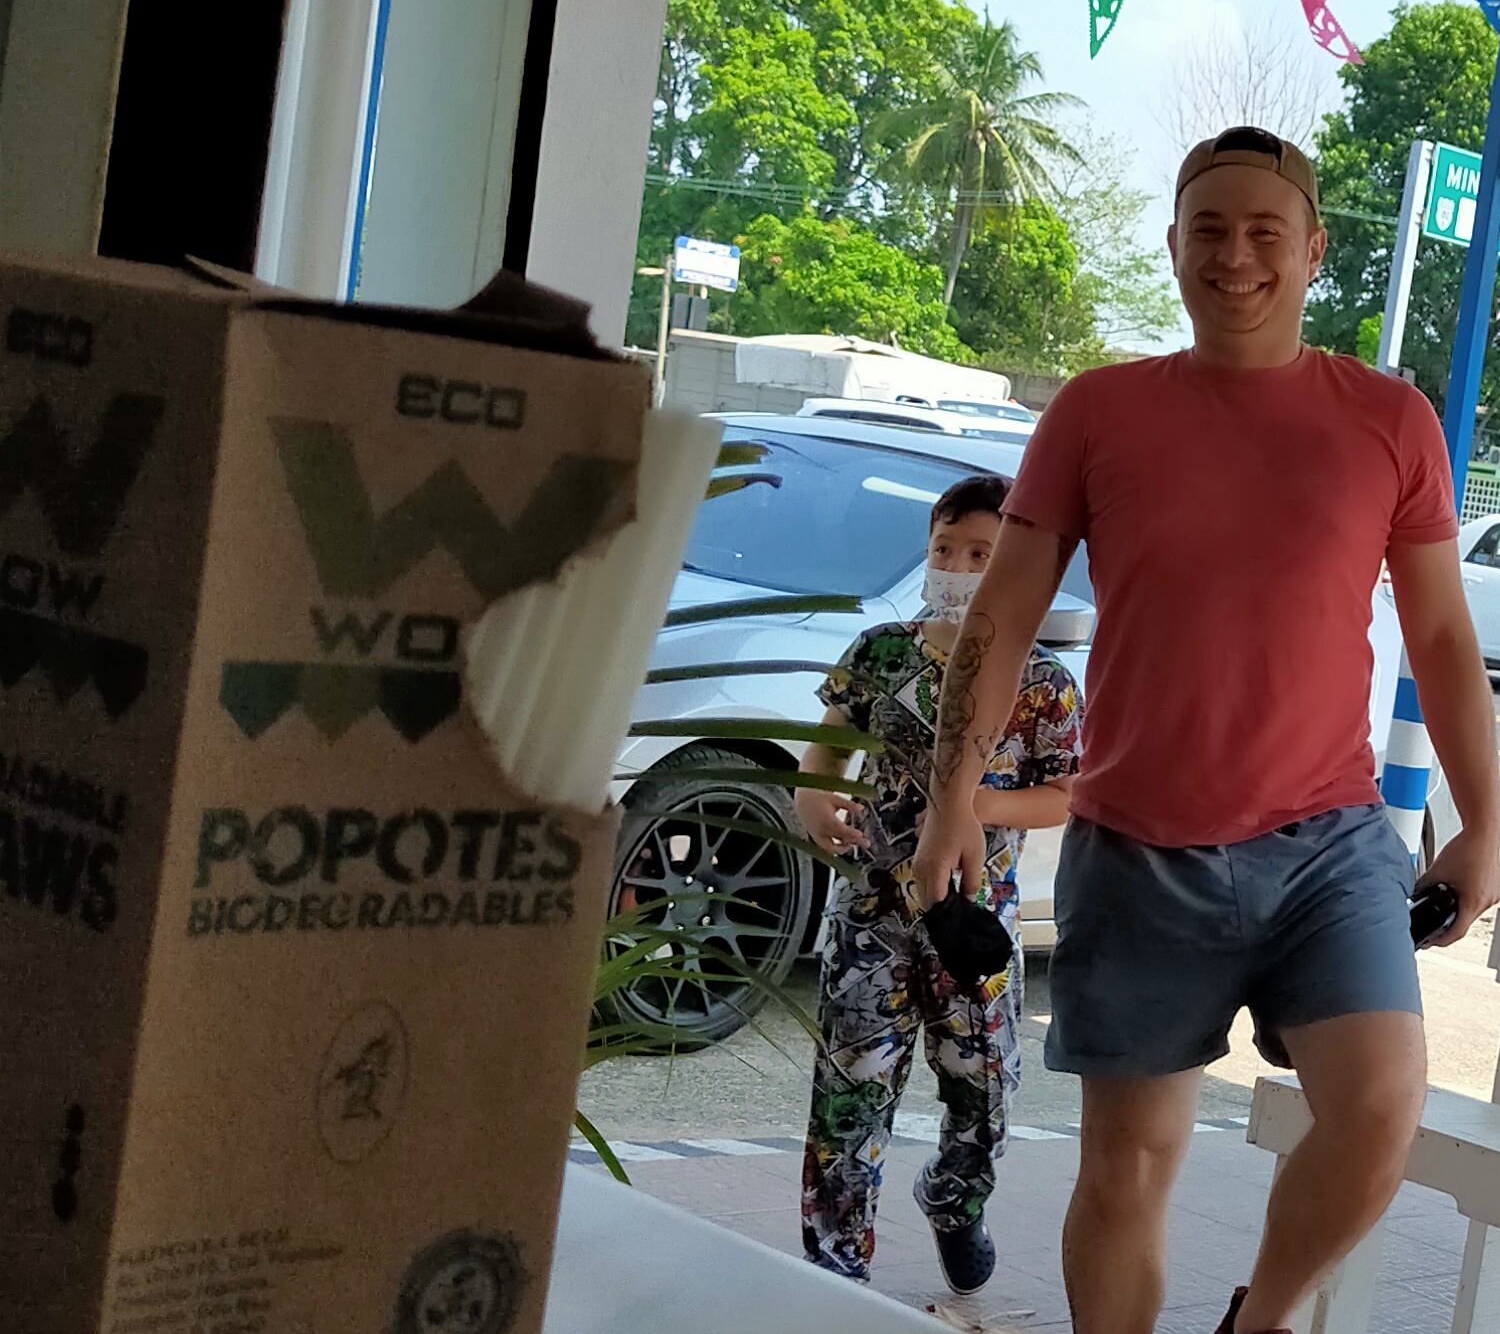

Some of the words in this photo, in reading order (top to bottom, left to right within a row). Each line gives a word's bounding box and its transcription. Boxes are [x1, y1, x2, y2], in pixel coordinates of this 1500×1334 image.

[395, 372, 527, 431] ECO
[0, 553, 105, 618] OW
[310, 605, 459, 664] WO
[193, 805, 582, 888] POPOTES
[186, 888, 576, 937] BIODEGRADABLES
